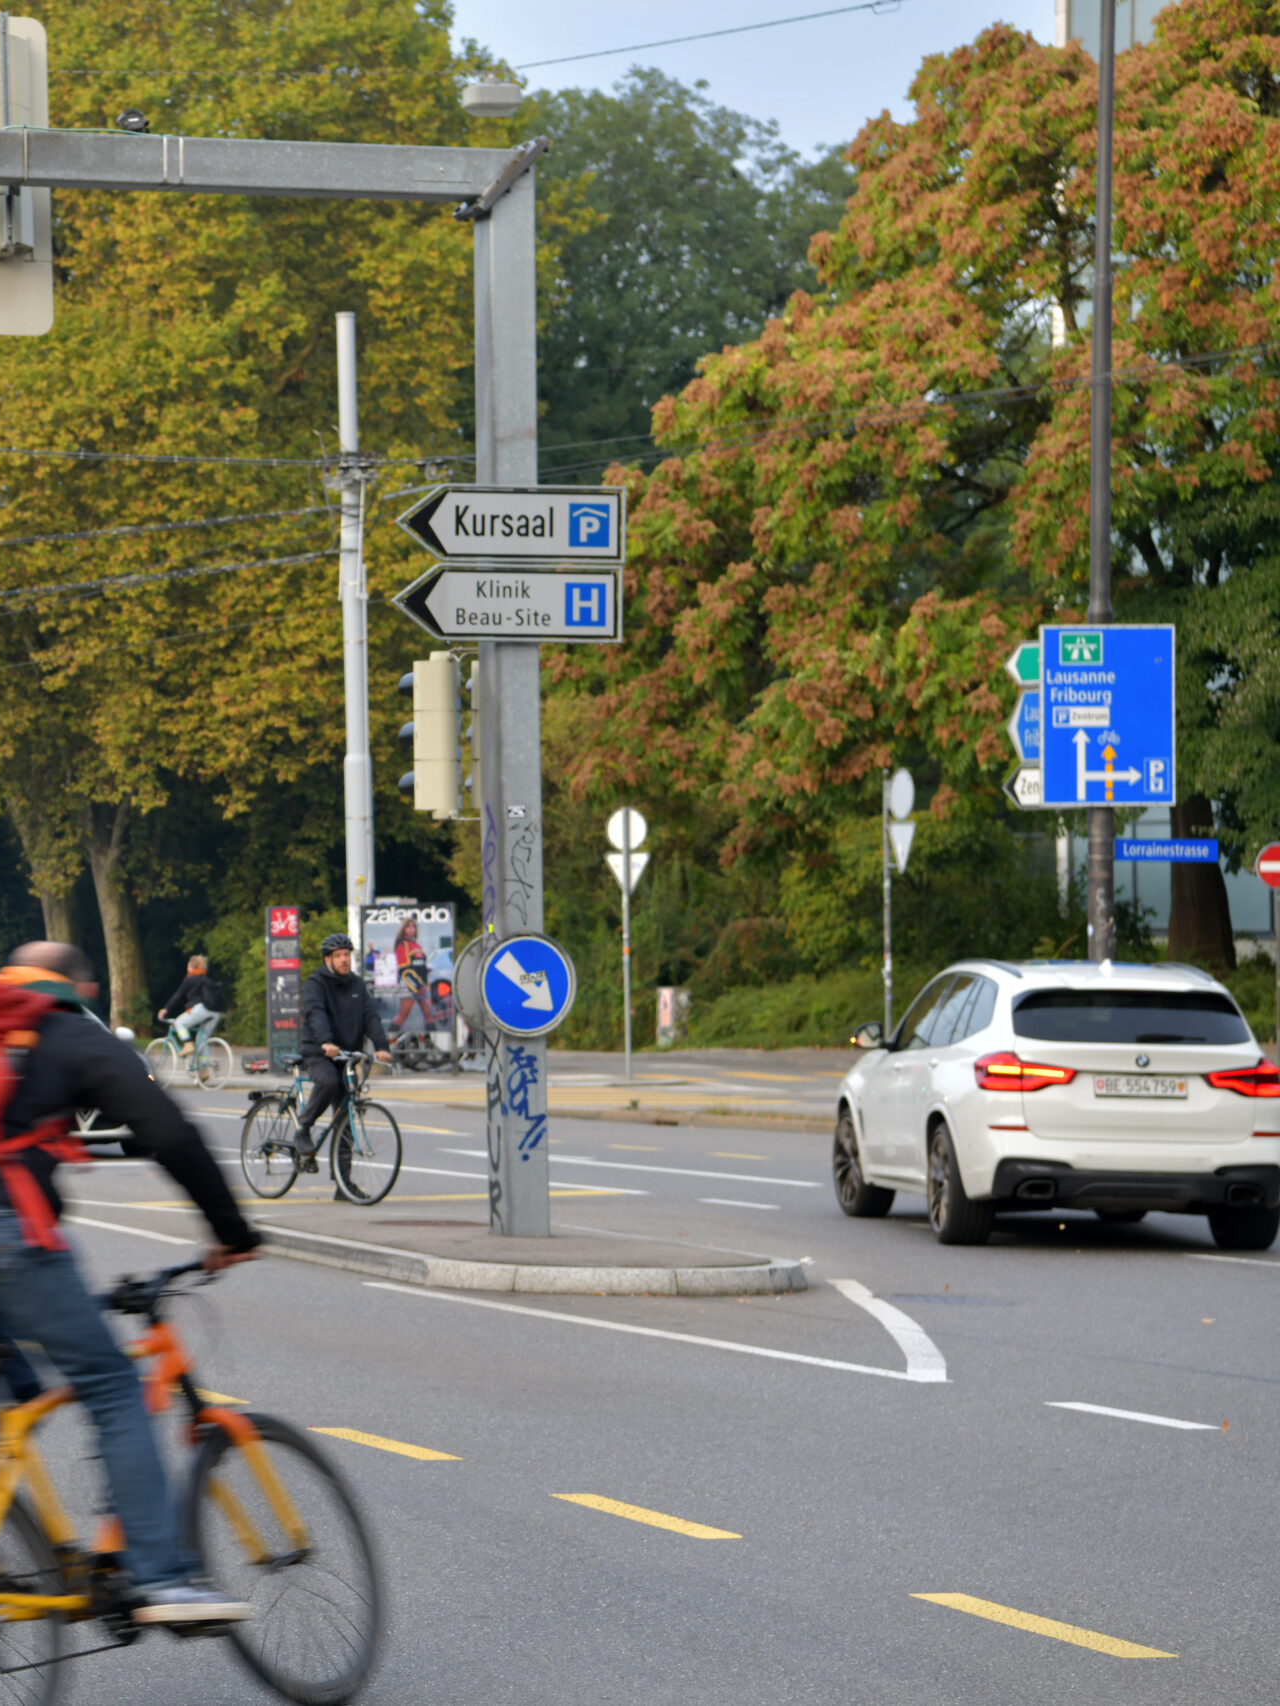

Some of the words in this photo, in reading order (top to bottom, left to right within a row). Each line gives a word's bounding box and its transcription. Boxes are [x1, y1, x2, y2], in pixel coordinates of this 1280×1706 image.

[454, 504, 555, 538] Kursaal
[579, 515, 601, 543] P
[476, 579, 531, 599] Klinik
[572, 587, 599, 622] H
[455, 606, 552, 627] Beau-Site
[1046, 668, 1116, 685] Lausanne
[1050, 687, 1113, 706] Fribourg
[1058, 710, 1068, 723] P
[1072, 710, 1109, 722] Zentrum
[1149, 759, 1165, 778] P
[1123, 842, 1210, 858] Lorrainestrasse
[365, 905, 451, 924] zalando
